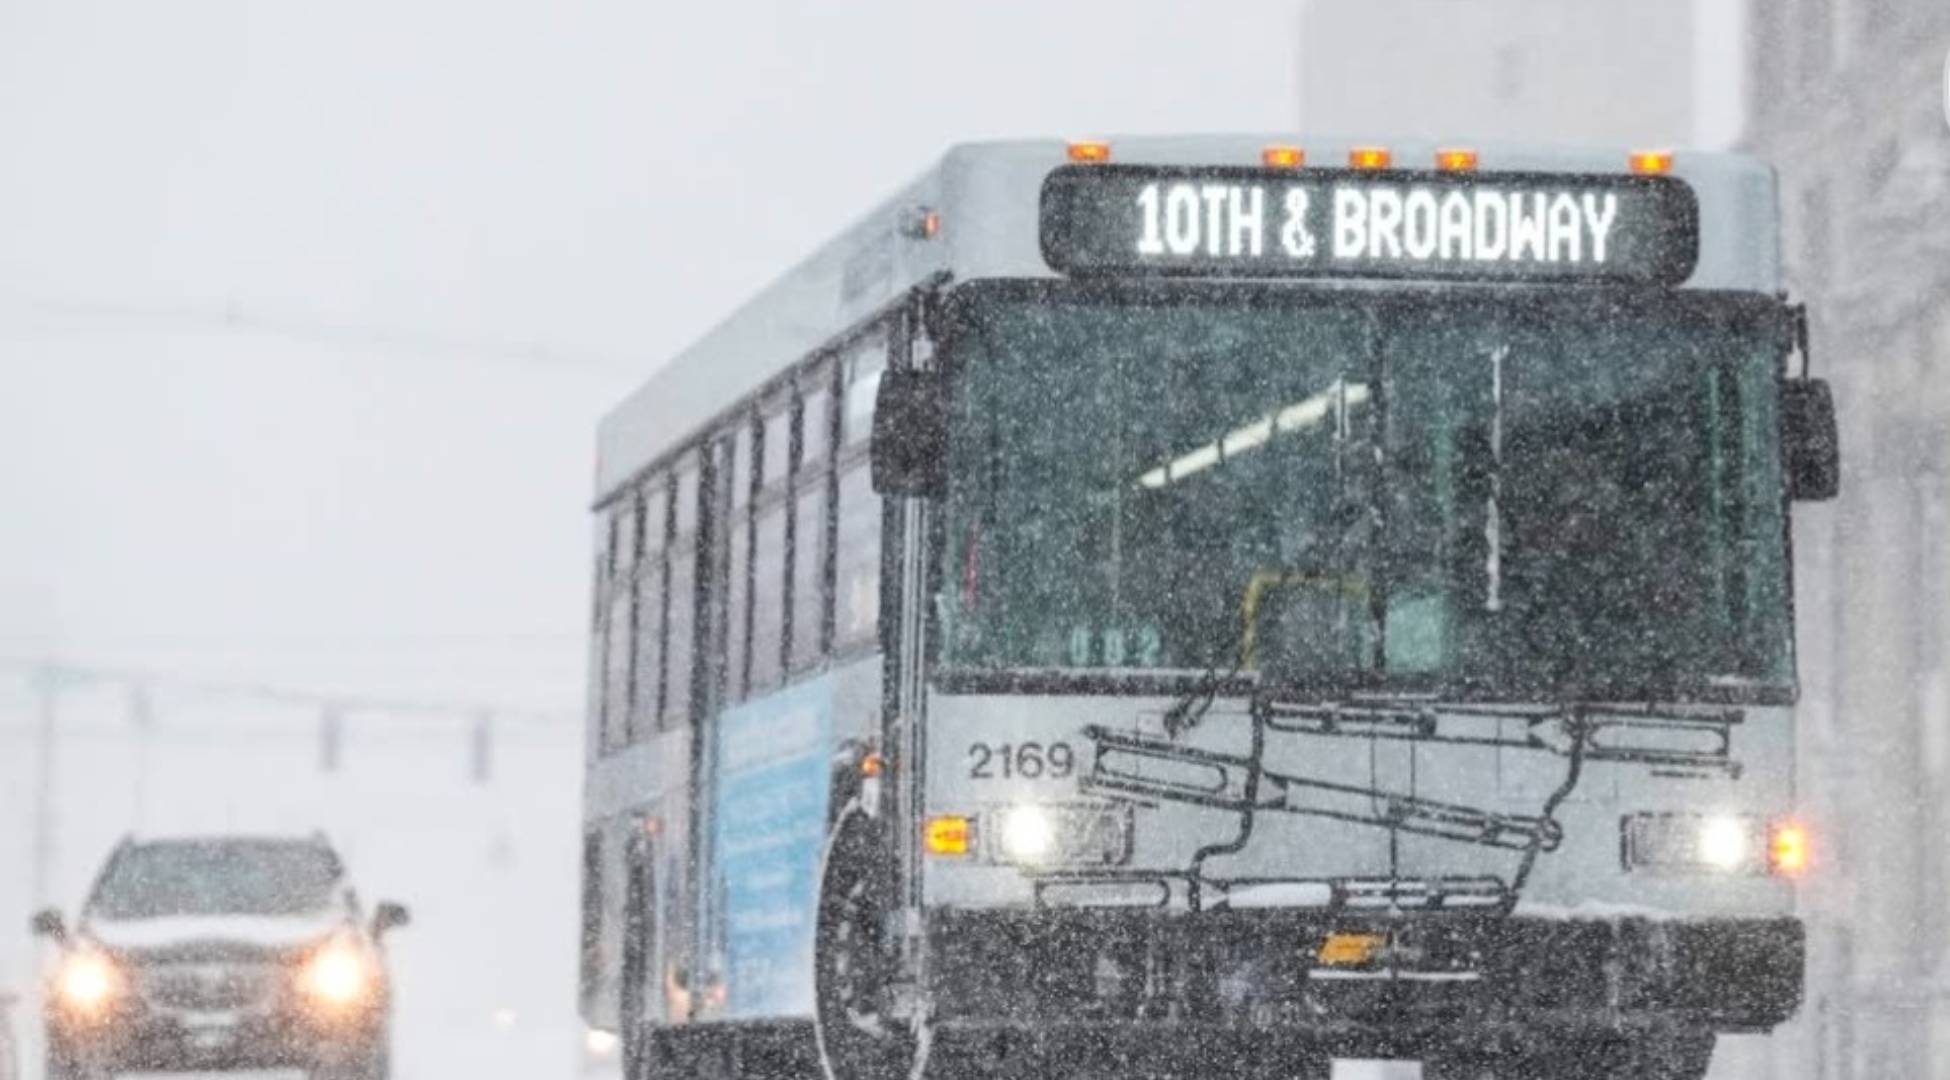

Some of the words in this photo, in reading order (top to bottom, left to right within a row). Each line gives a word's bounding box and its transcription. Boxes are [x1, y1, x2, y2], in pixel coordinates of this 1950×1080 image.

[1136, 184, 1262, 257] 10TH
[1280, 190, 1316, 259] &
[1334, 188, 1617, 262] BROADWAY
[968, 741, 1074, 779] 2169
